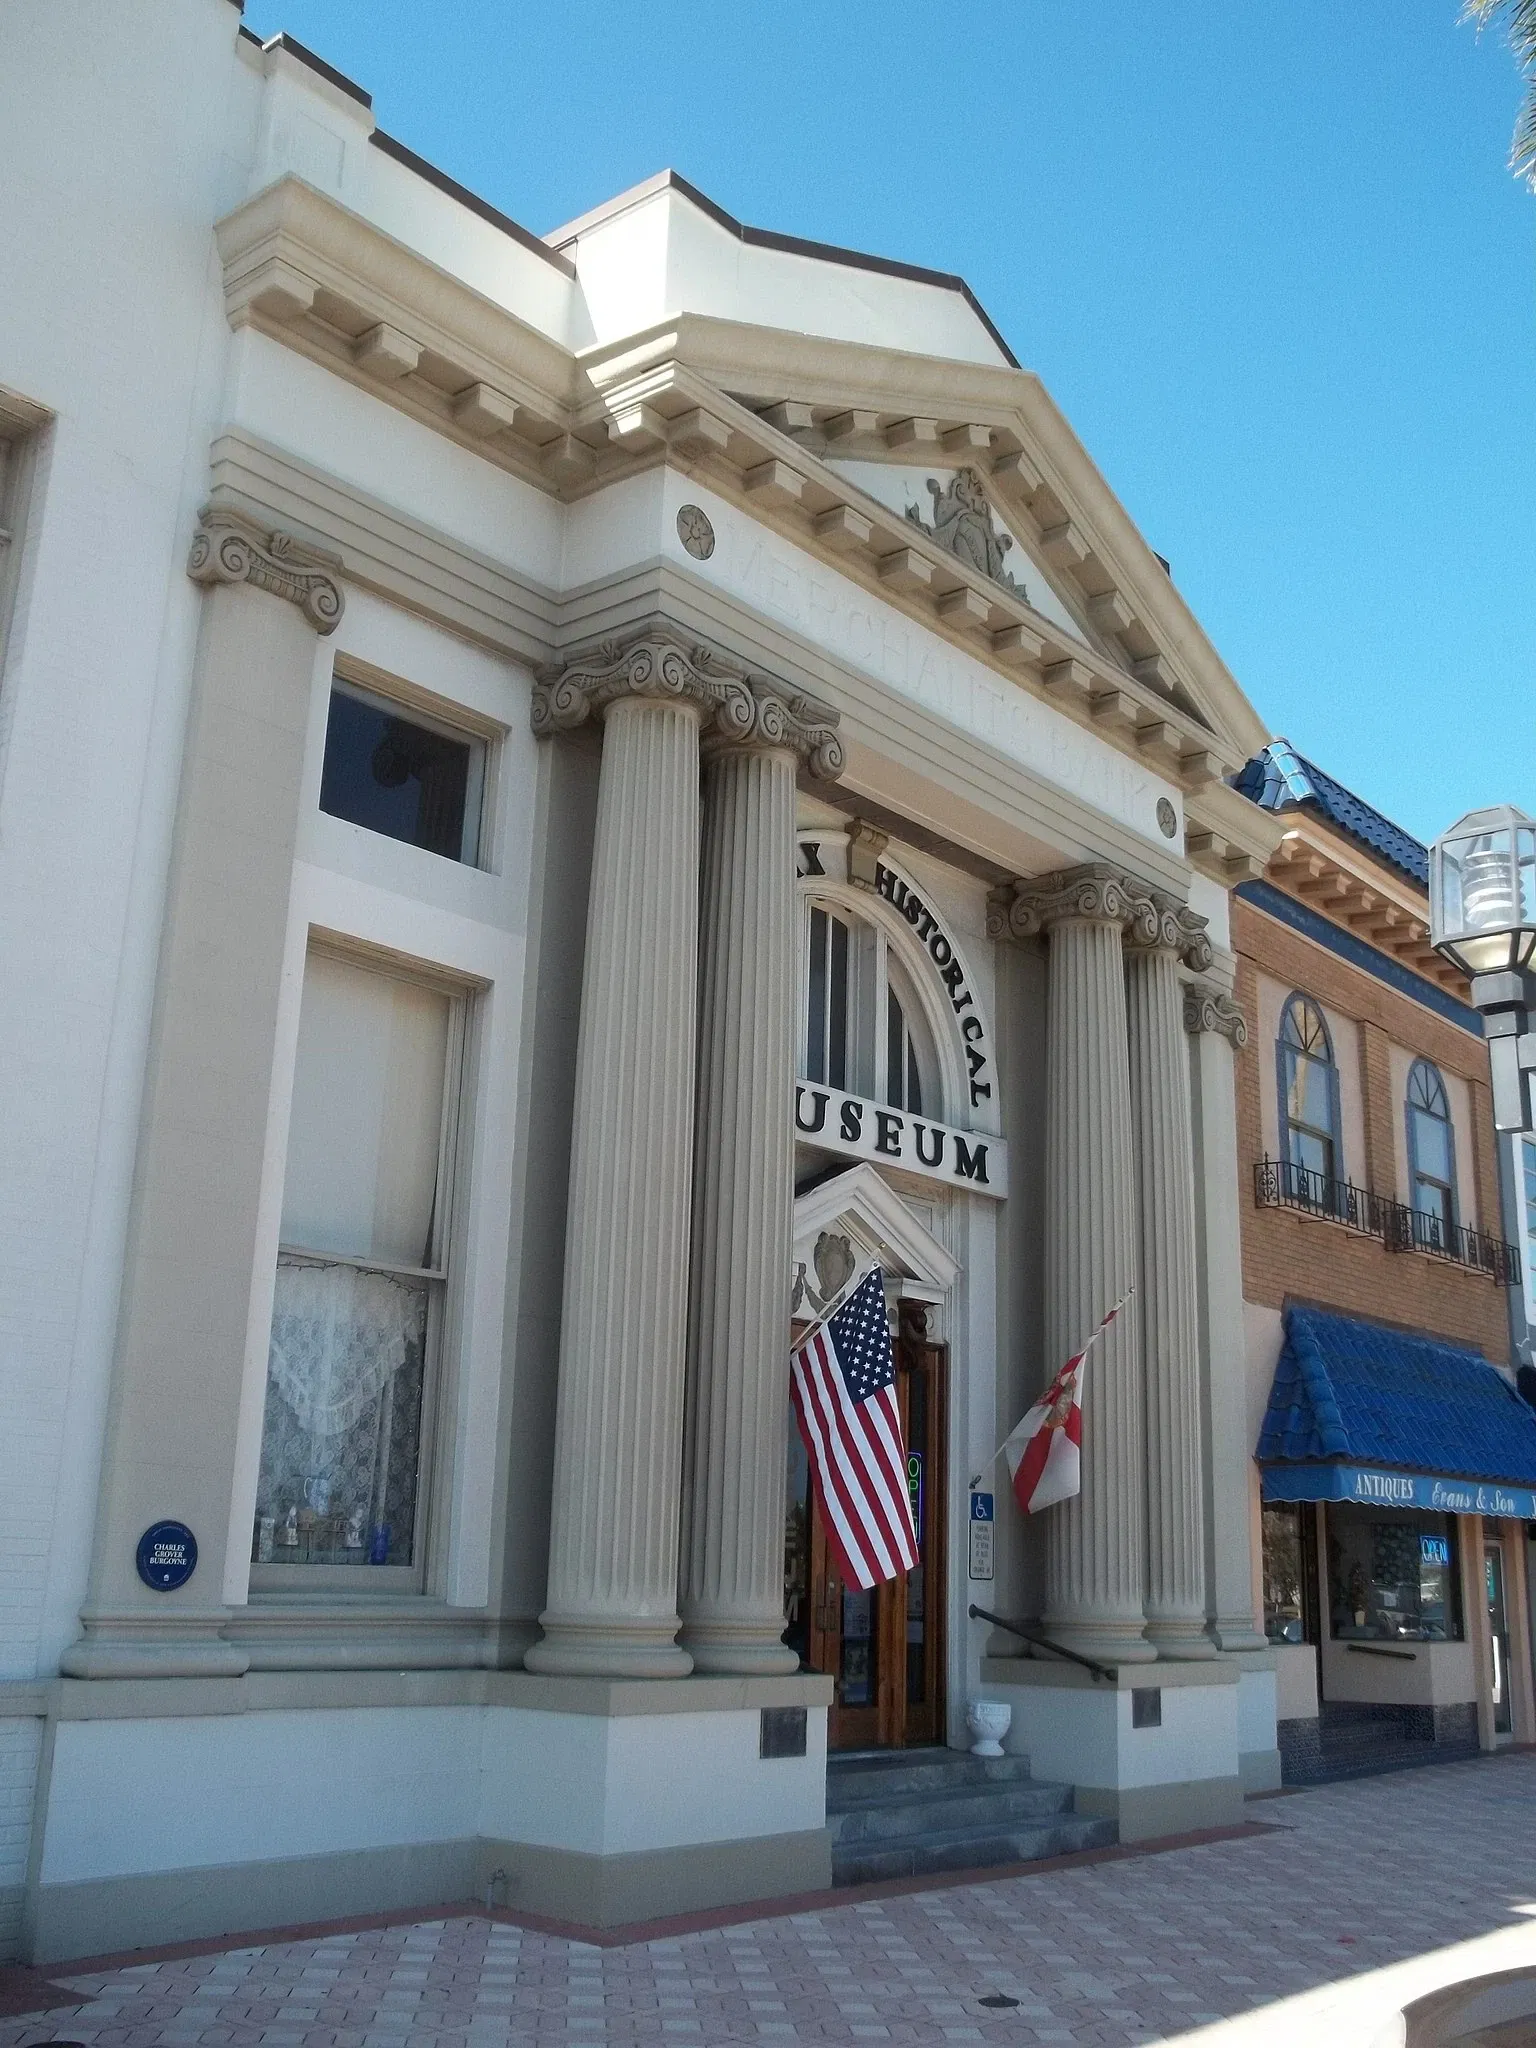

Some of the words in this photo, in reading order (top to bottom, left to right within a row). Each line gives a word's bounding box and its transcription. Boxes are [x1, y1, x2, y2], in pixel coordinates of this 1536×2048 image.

[876, 861, 991, 1108] HISTORICAL
[1354, 1473, 1414, 1501] ANTIQUES
[1431, 1481, 1470, 1507] Evans
[1475, 1486, 1486, 1510] &
[1490, 1489, 1516, 1512] Son
[153, 1543, 186, 1552] CHARLES
[154, 1550, 183, 1558] GROVER
[1422, 1538, 1448, 1563] OPEN
[149, 1556, 187, 1566] BURGOYNE
